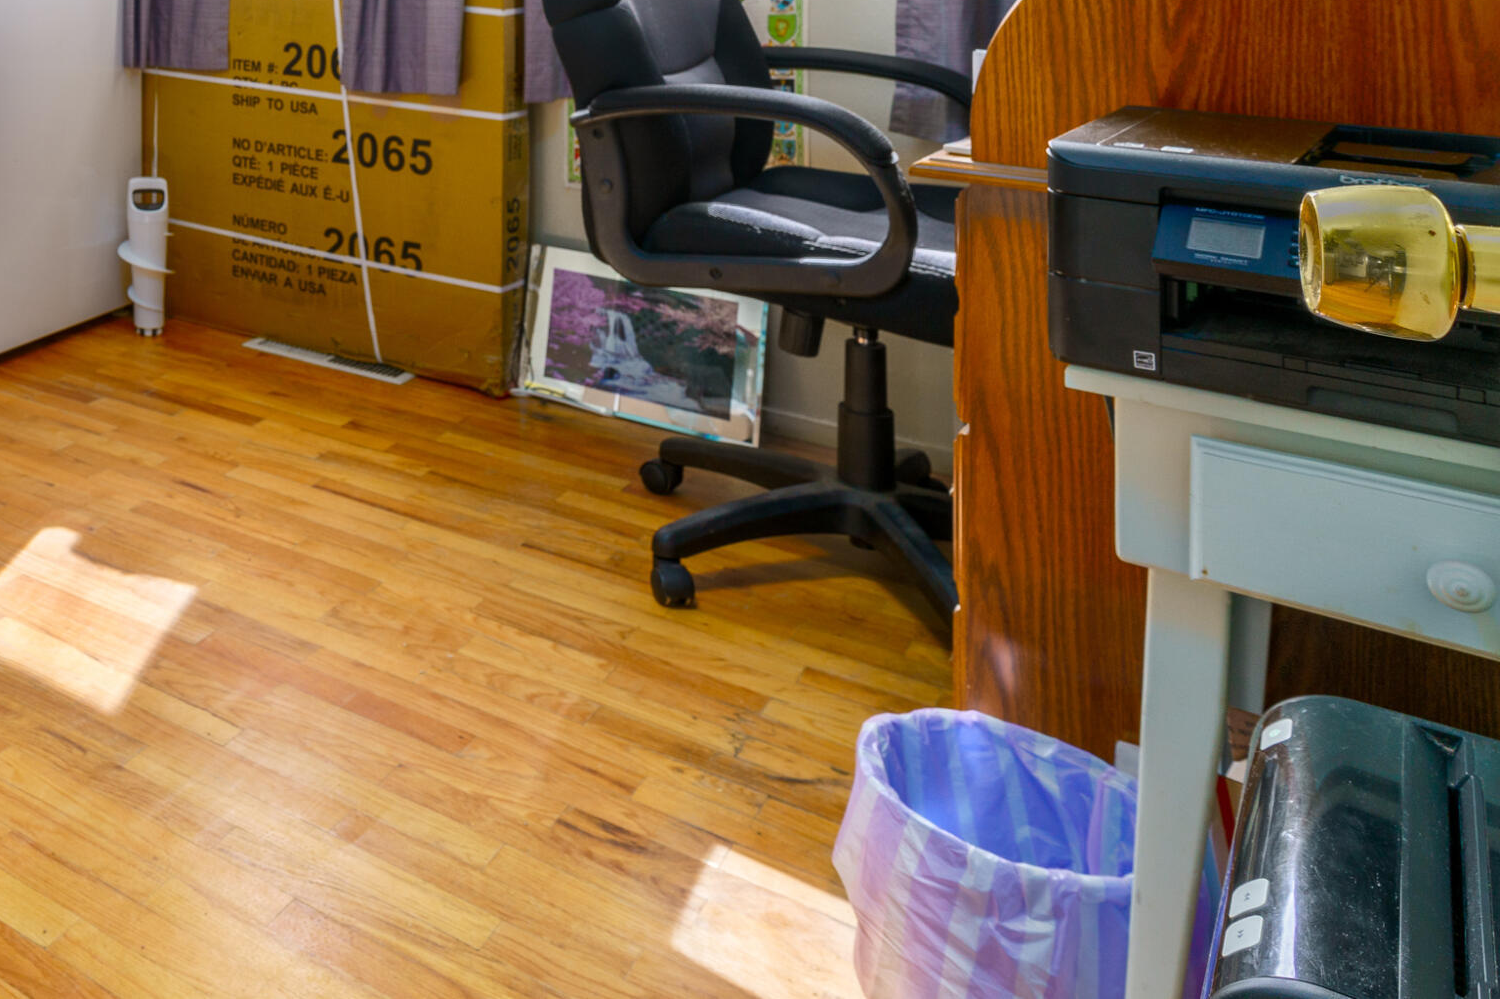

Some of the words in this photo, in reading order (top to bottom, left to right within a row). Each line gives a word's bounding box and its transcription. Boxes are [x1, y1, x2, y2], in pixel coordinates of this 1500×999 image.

[233, 59, 261, 73] ITEM
[232, 94, 260, 107] SHIP
[267, 98, 284, 111] TO
[291, 101, 318, 115] USA
[232, 138, 250, 150] NO
[255, 141, 329, 162] D'ARTICLE:
[332, 129, 433, 175] 2065
[232, 155, 261, 170] QTÉ:
[281, 161, 319, 179] PIÈCE
[232, 173, 285, 193] EXPÉDIÉ
[291, 183, 318, 198] AUX
[232, 214, 287, 235] NÚMERO
[505, 196, 521, 274] 2065
[324, 227, 423, 278] 2065
[232, 249, 300, 274] CANTIDAD:
[318, 266, 358, 285] PIEZA
[232, 265, 277, 285] ENVIAR
[298, 280, 327, 295] USA
